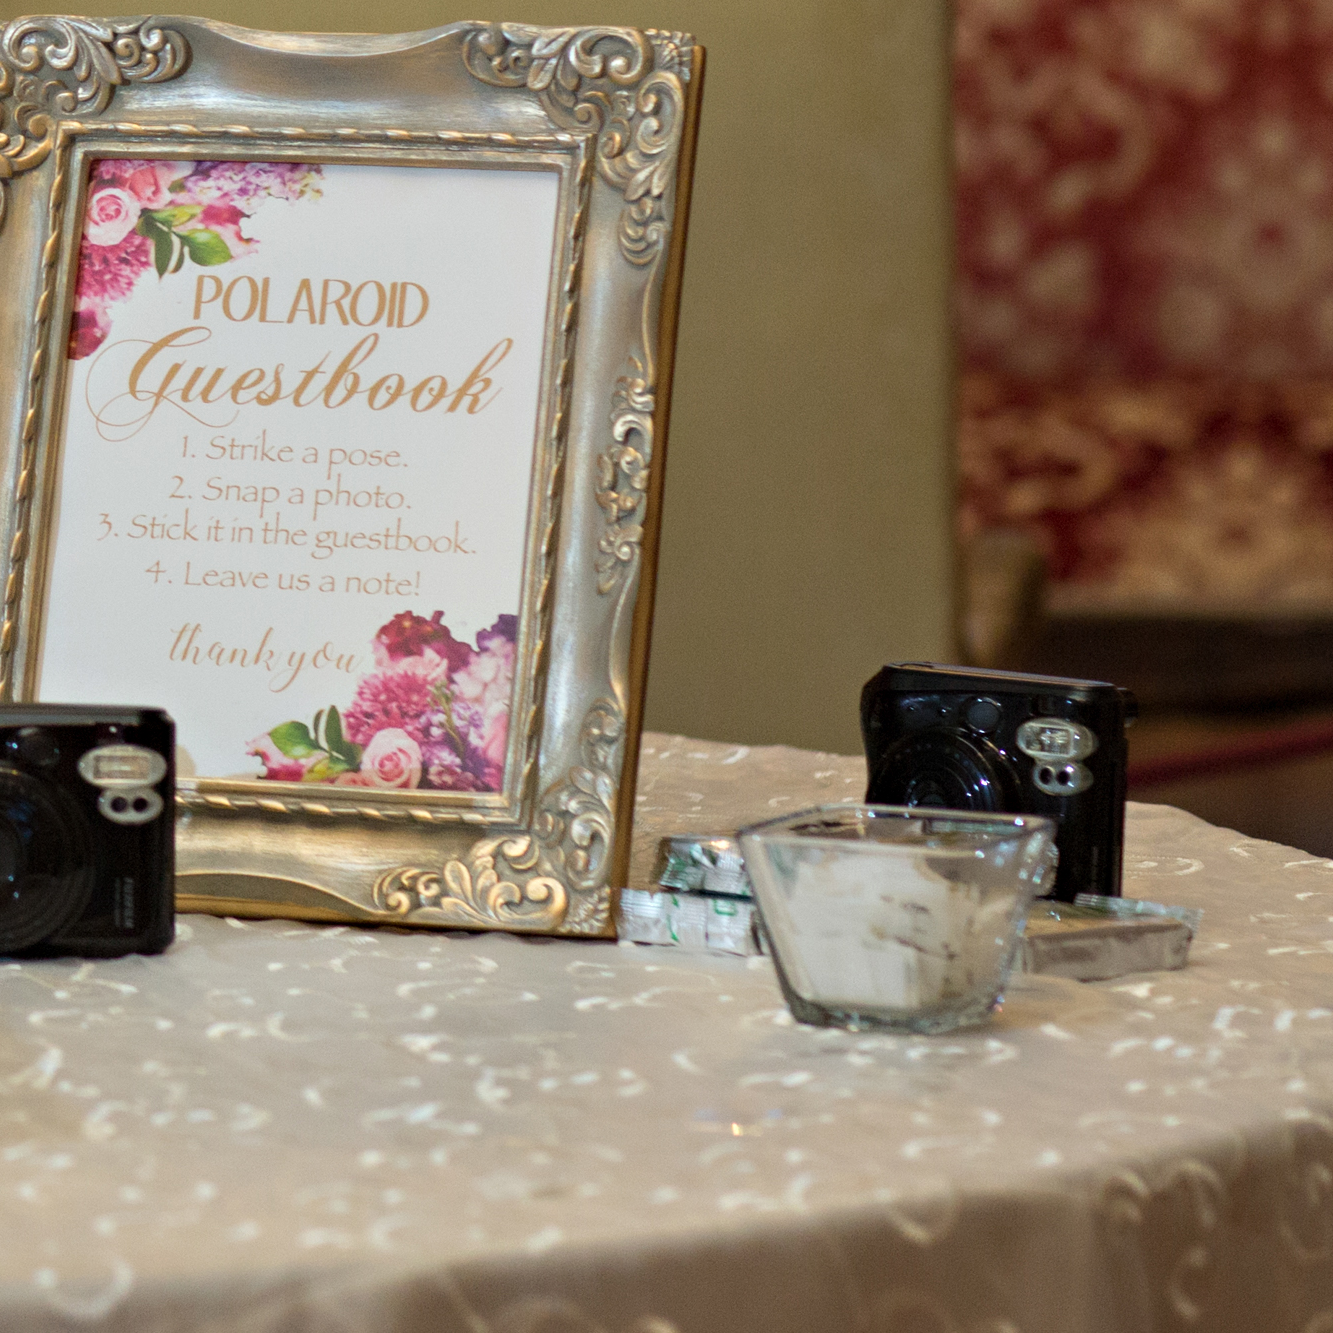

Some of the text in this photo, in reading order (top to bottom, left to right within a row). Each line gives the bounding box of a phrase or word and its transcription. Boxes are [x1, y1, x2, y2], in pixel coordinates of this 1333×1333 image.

[192, 274, 430, 329] POLAROID
[85, 325, 514, 443] Guestbook
[181, 428, 409, 481] 1. Strike a pose.
[168, 472, 412, 522] 2. Snap a photo.
[97, 507, 477, 559] 3. Stick it in the guestbook.
[144, 559, 421, 597] 4. Leave us a note!
[170, 622, 363, 693] thank you
